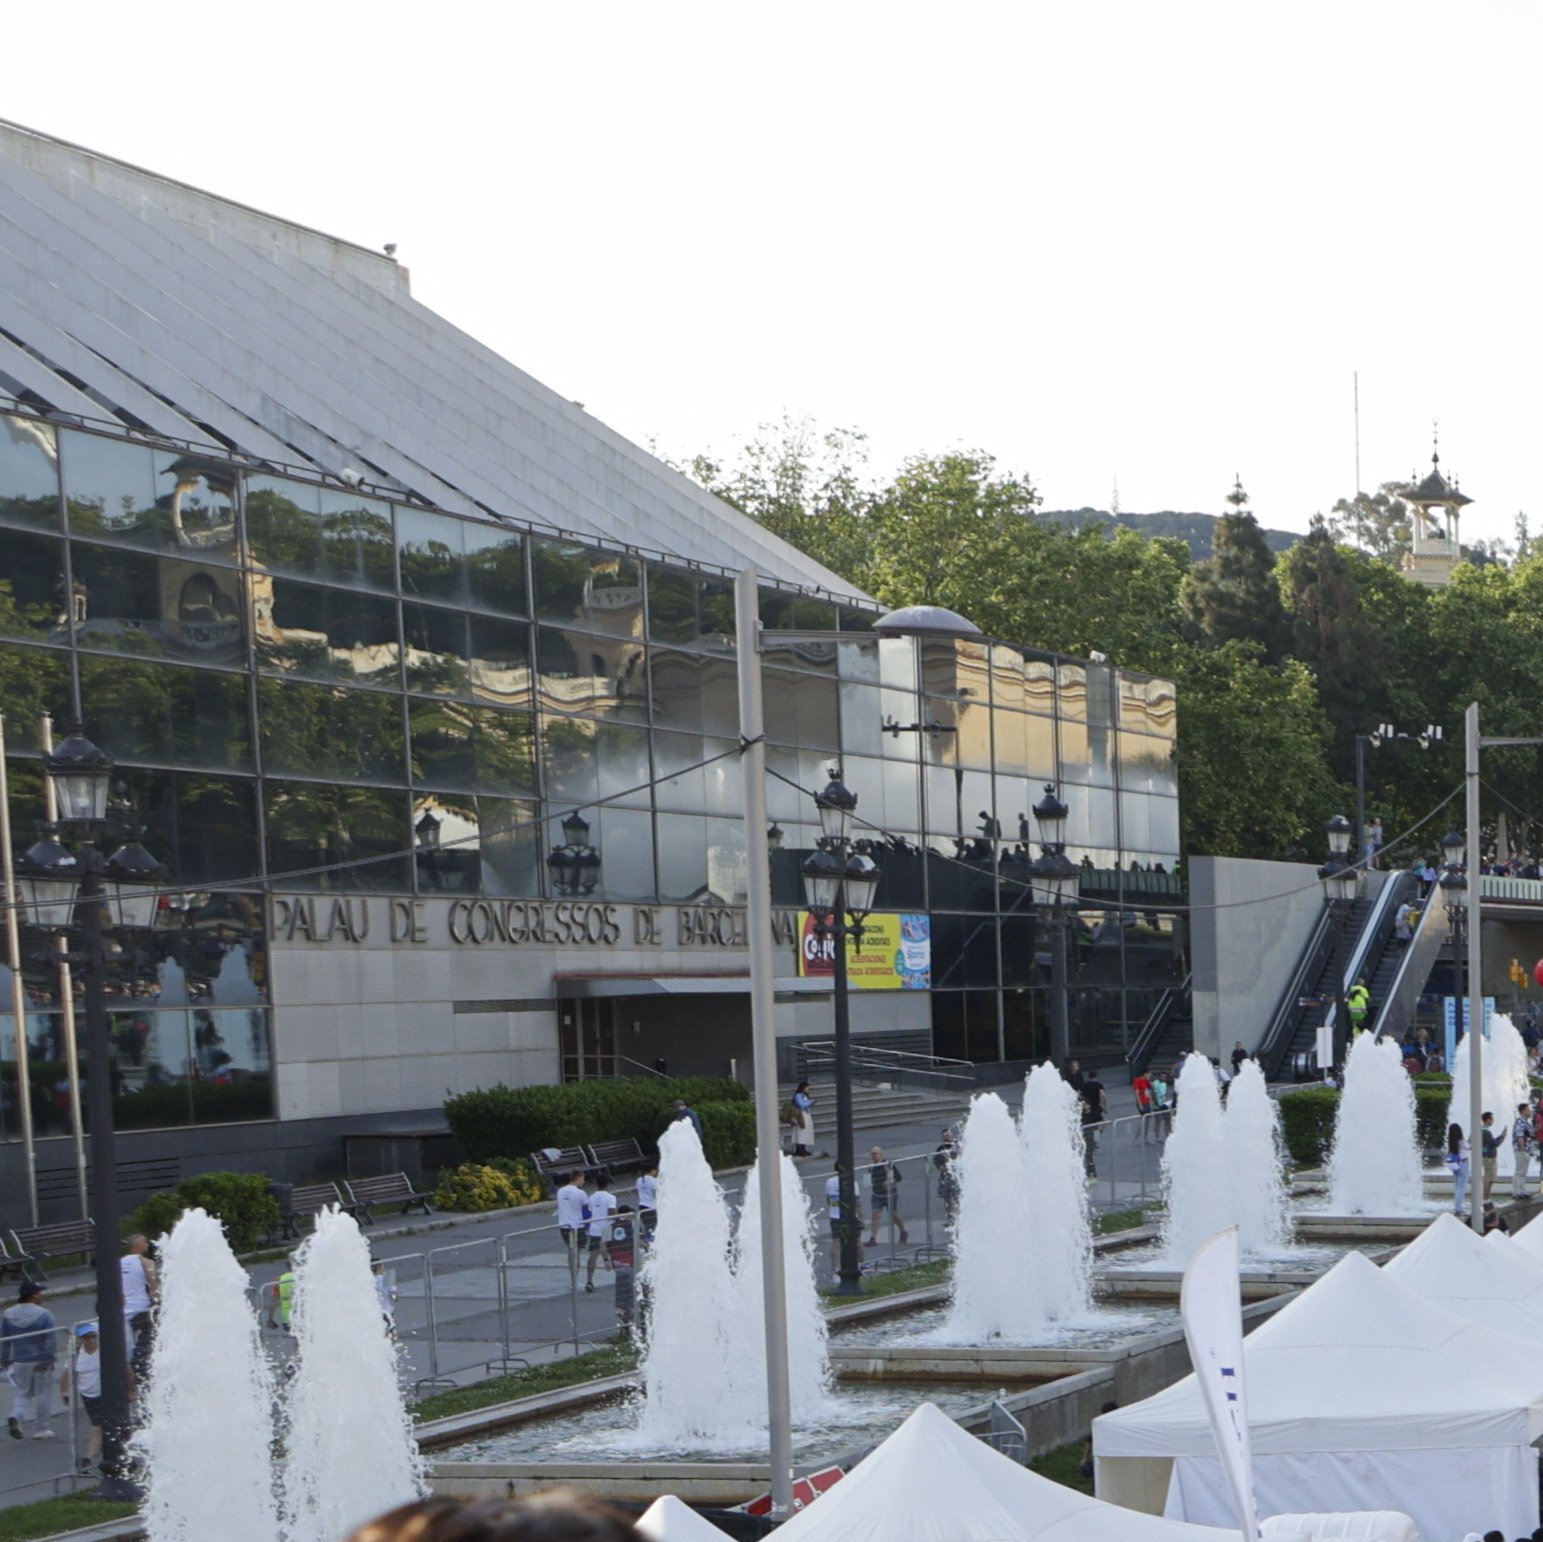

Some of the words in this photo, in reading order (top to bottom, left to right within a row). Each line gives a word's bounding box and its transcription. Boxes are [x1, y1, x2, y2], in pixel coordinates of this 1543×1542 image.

[267, 897, 369, 942] PALAU
[390, 898, 428, 943] DE
[449, 899, 621, 946] CONGRESSOS
[633, 905, 662, 946] DE
[677, 906, 797, 948] BARCELNA
